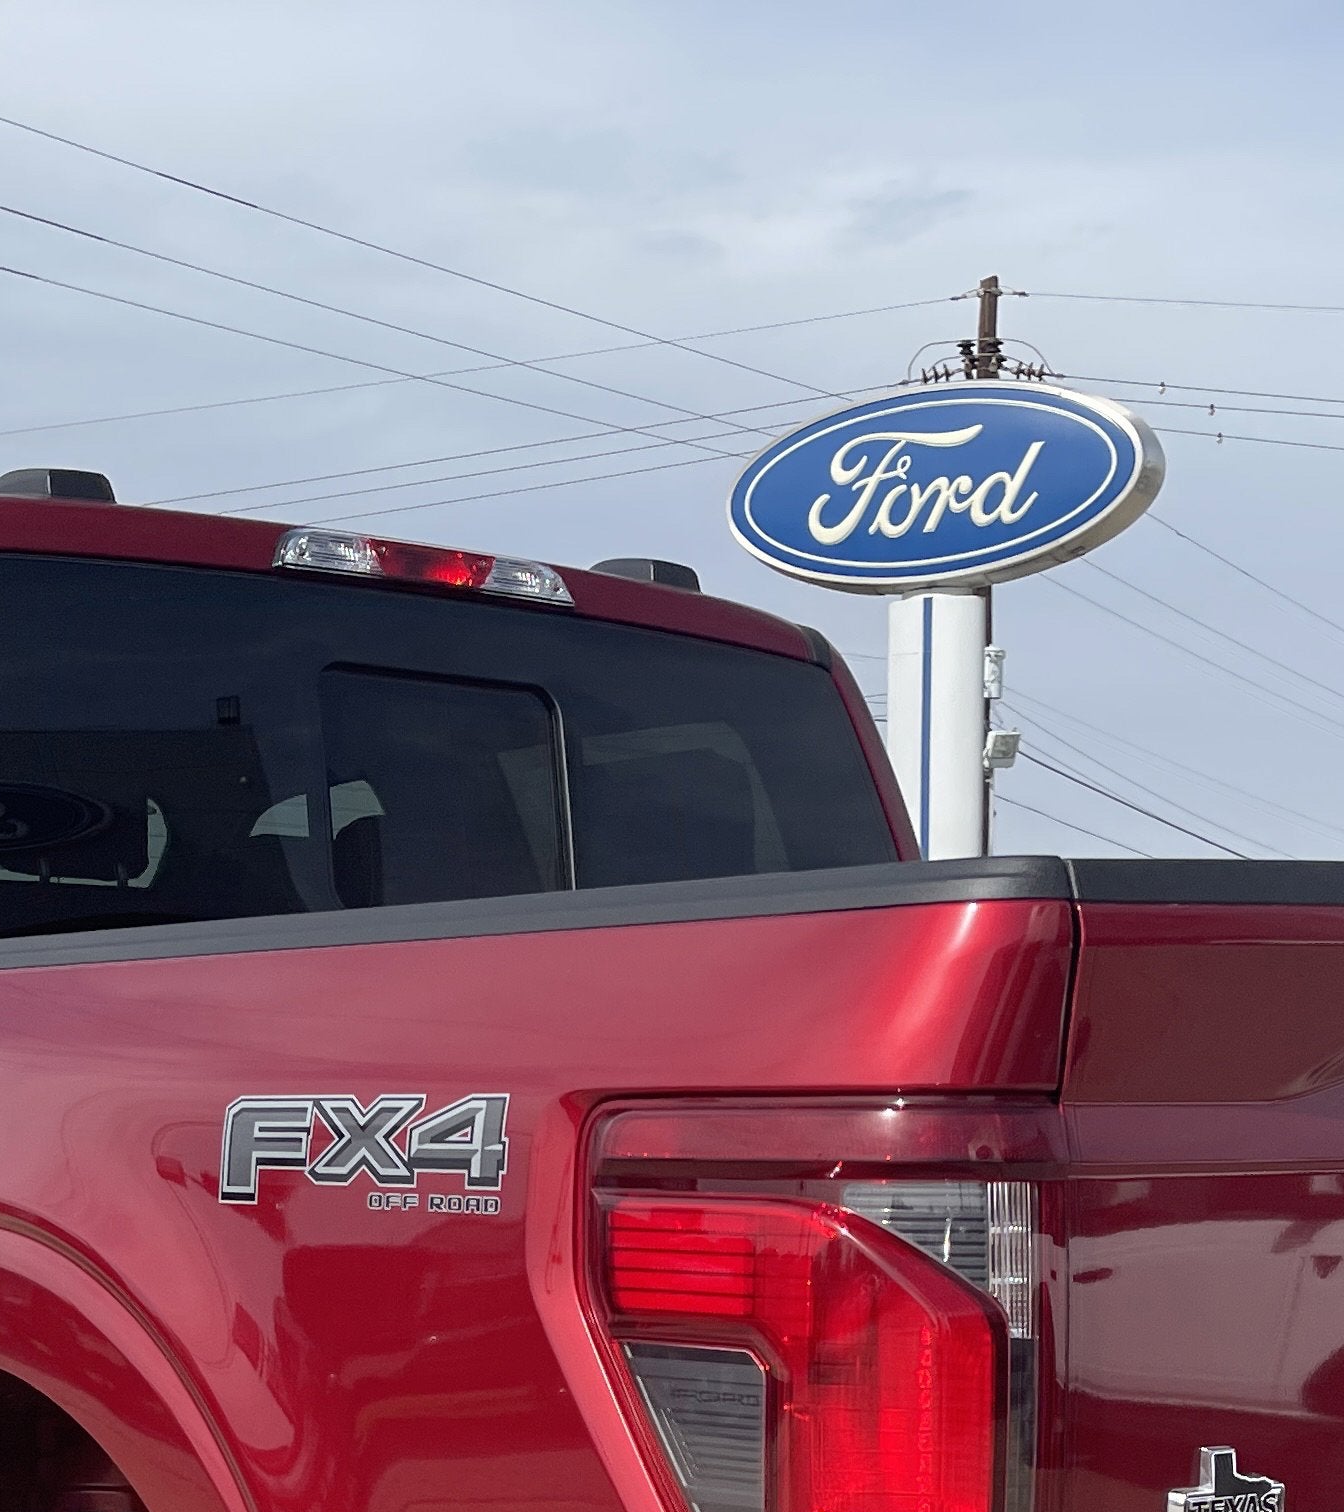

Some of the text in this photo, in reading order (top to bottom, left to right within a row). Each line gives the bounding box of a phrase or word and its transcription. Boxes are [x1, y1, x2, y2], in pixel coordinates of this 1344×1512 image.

[807, 424, 1045, 546] Ford
[218, 1093, 510, 1204] FX4
[367, 1192, 501, 1215] OFF ROAD
